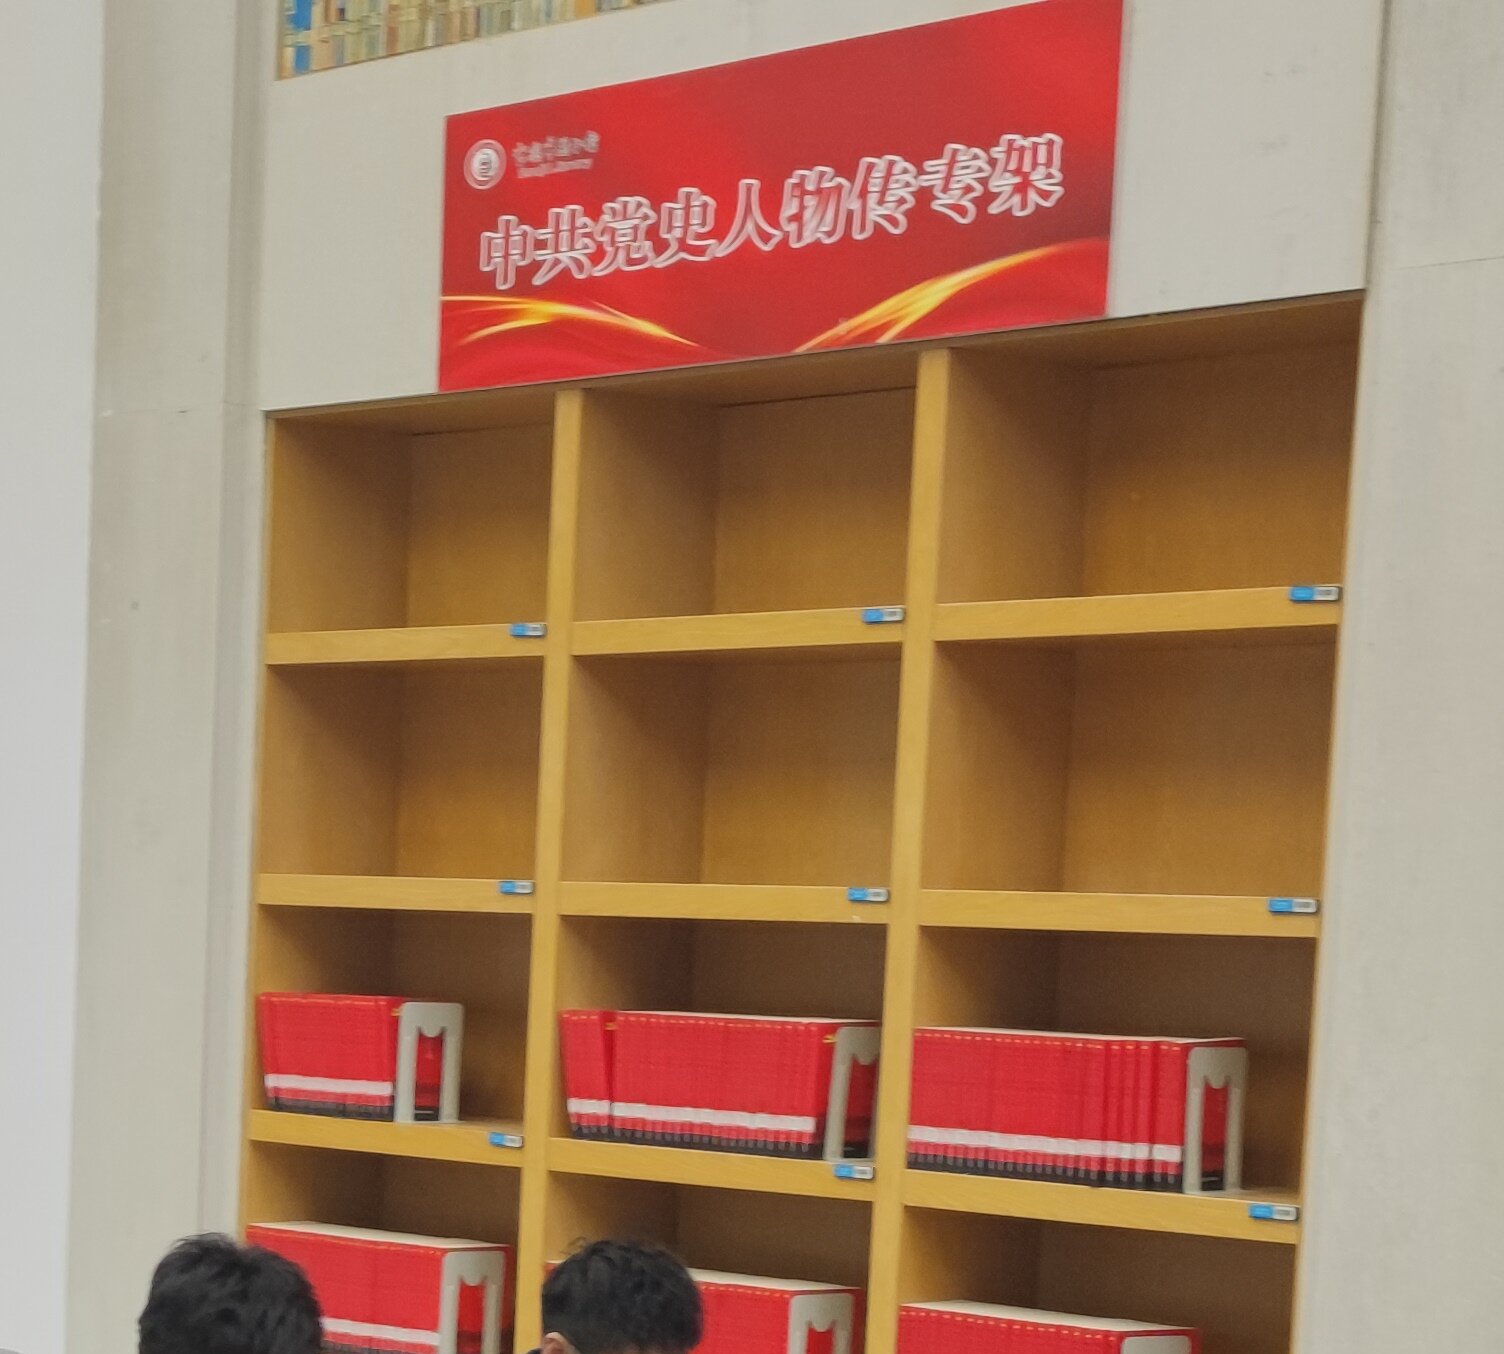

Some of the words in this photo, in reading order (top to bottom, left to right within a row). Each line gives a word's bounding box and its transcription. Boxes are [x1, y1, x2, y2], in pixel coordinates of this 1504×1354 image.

[479, 131, 1065, 291] 中共党史人物传专架
